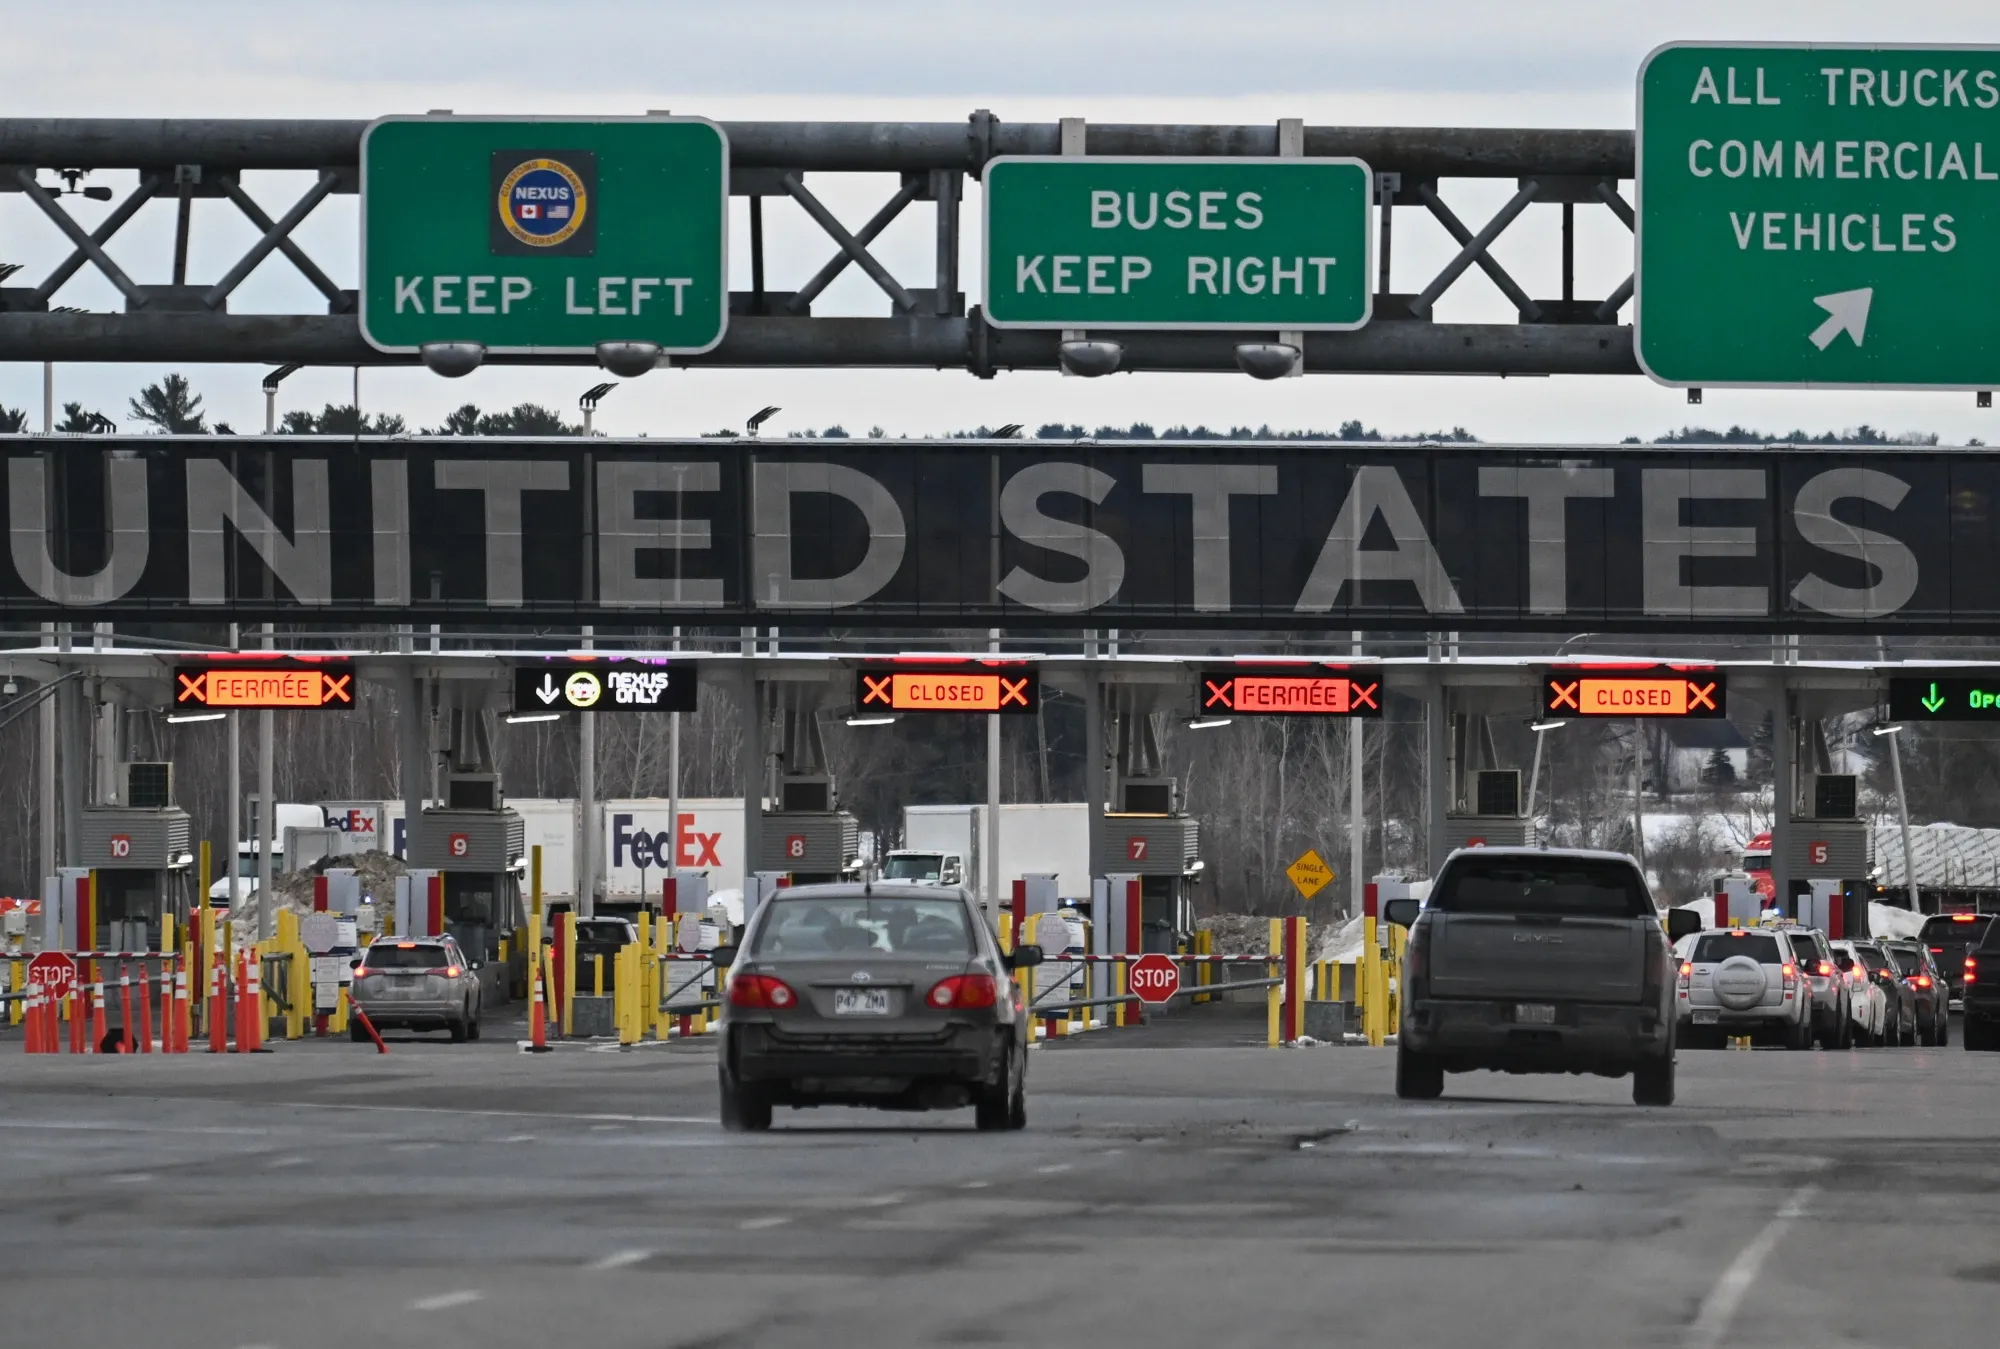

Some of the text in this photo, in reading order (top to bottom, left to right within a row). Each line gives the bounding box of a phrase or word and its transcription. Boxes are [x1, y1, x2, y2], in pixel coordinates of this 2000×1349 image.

[1690, 66, 2000, 108] ALL TRUCKS
[1688, 139, 2000, 181] COMMERCIAL
[516, 187, 569, 200] NEXUS
[1090, 190, 1263, 230] BUSES
[1729, 212, 1957, 252] VEHICLES
[1016, 255, 1336, 295] KEEP RIGHT
[394, 276, 693, 315] KEEP LEFT
[8, 458, 1920, 618] UNITED STATES
[216, 673, 309, 698] FERMÉE
[608, 671, 669, 689] NEXUS
[615, 688, 662, 704] ONLY
[910, 685, 984, 701] CLOSED
[1243, 680, 1337, 706] FERMÉE
[1597, 689, 1671, 706] CLOSED
[327, 810, 375, 832] edEx
[111, 839, 130, 857] 10
[453, 838, 467, 856] 9
[791, 839, 804, 857] 8
[1133, 841, 1146, 859] 7
[1815, 846, 1828, 864] 5
[1295, 862, 1324, 874] SINGLE
[1297, 875, 1320, 886] LANE
[30, 965, 74, 985] STOP
[1133, 968, 1177, 988] STOP
